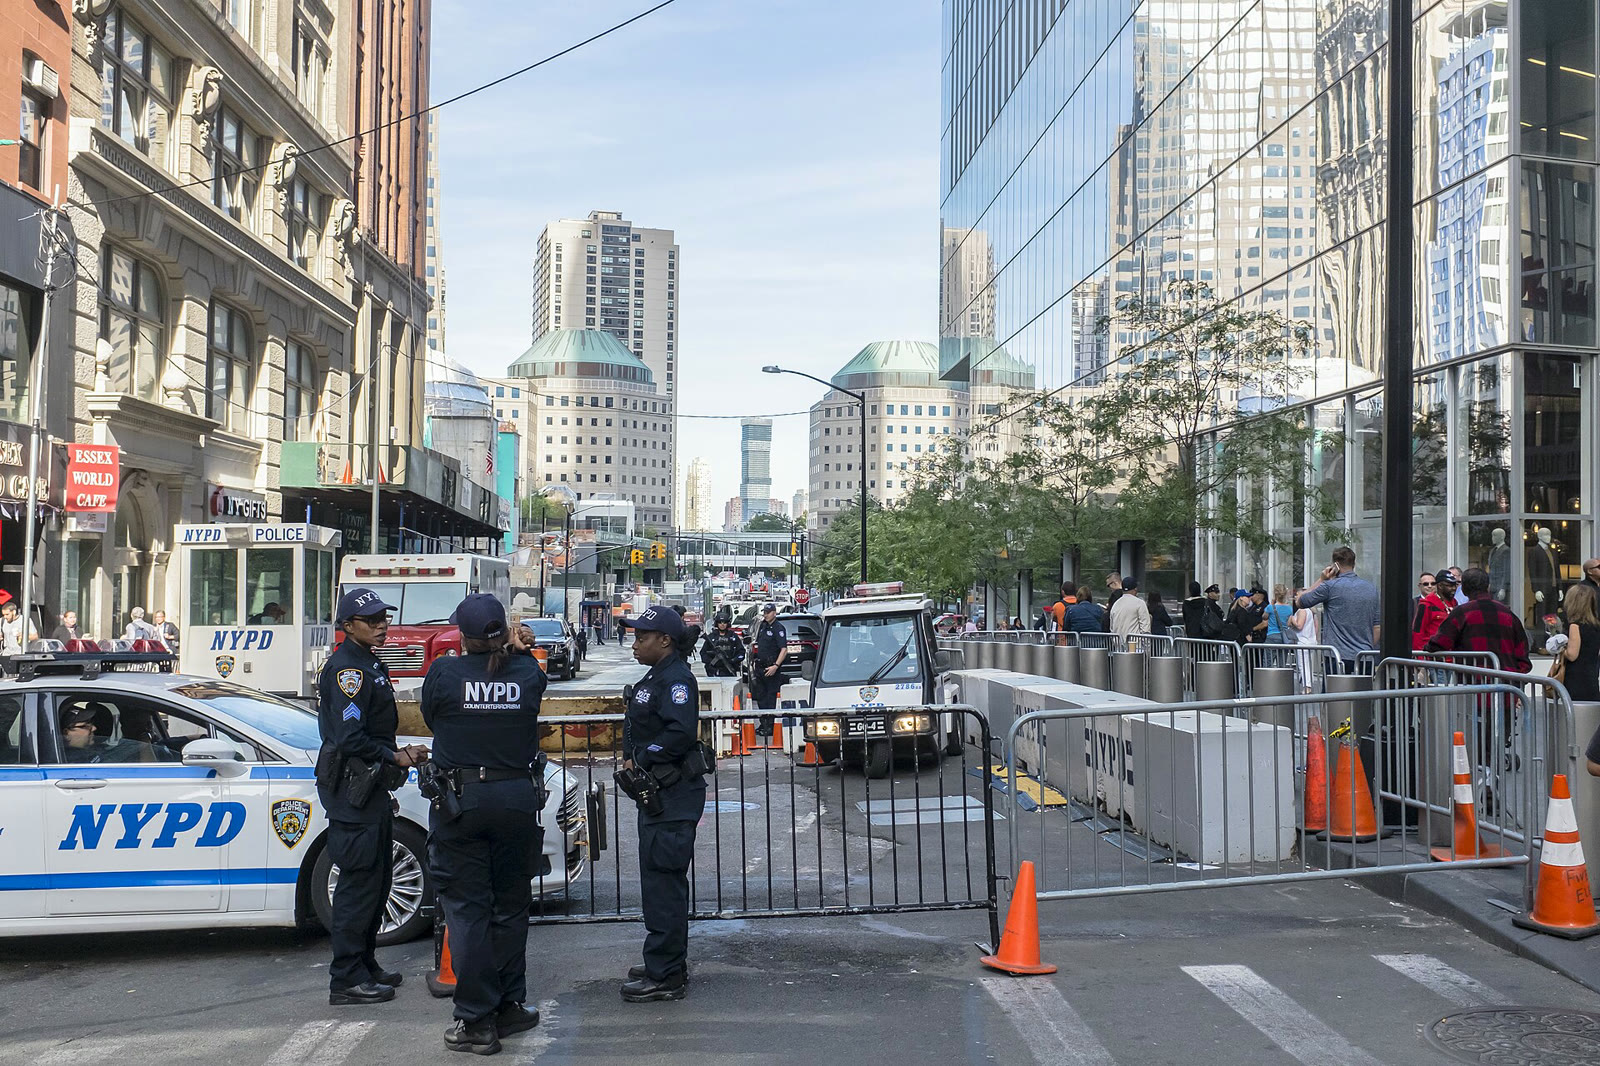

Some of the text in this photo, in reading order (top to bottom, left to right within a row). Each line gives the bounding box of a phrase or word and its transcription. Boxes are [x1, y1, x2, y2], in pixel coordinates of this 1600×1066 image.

[75, 450, 113, 465] ESSEX
[72, 471, 114, 486] WORLD
[77, 493, 107, 507] CAFE
[227, 496, 267, 520] NY GIFTS
[184, 529, 221, 542] NYPD
[256, 528, 304, 541] POLICE
[355, 591, 380, 608] NYP
[210, 630, 274, 651] NYPD
[310, 626, 328, 647] NYPD
[465, 681, 521, 702] NYPD
[273, 806, 309, 816] DEPARTMENT
[58, 801, 247, 850] NYPD
